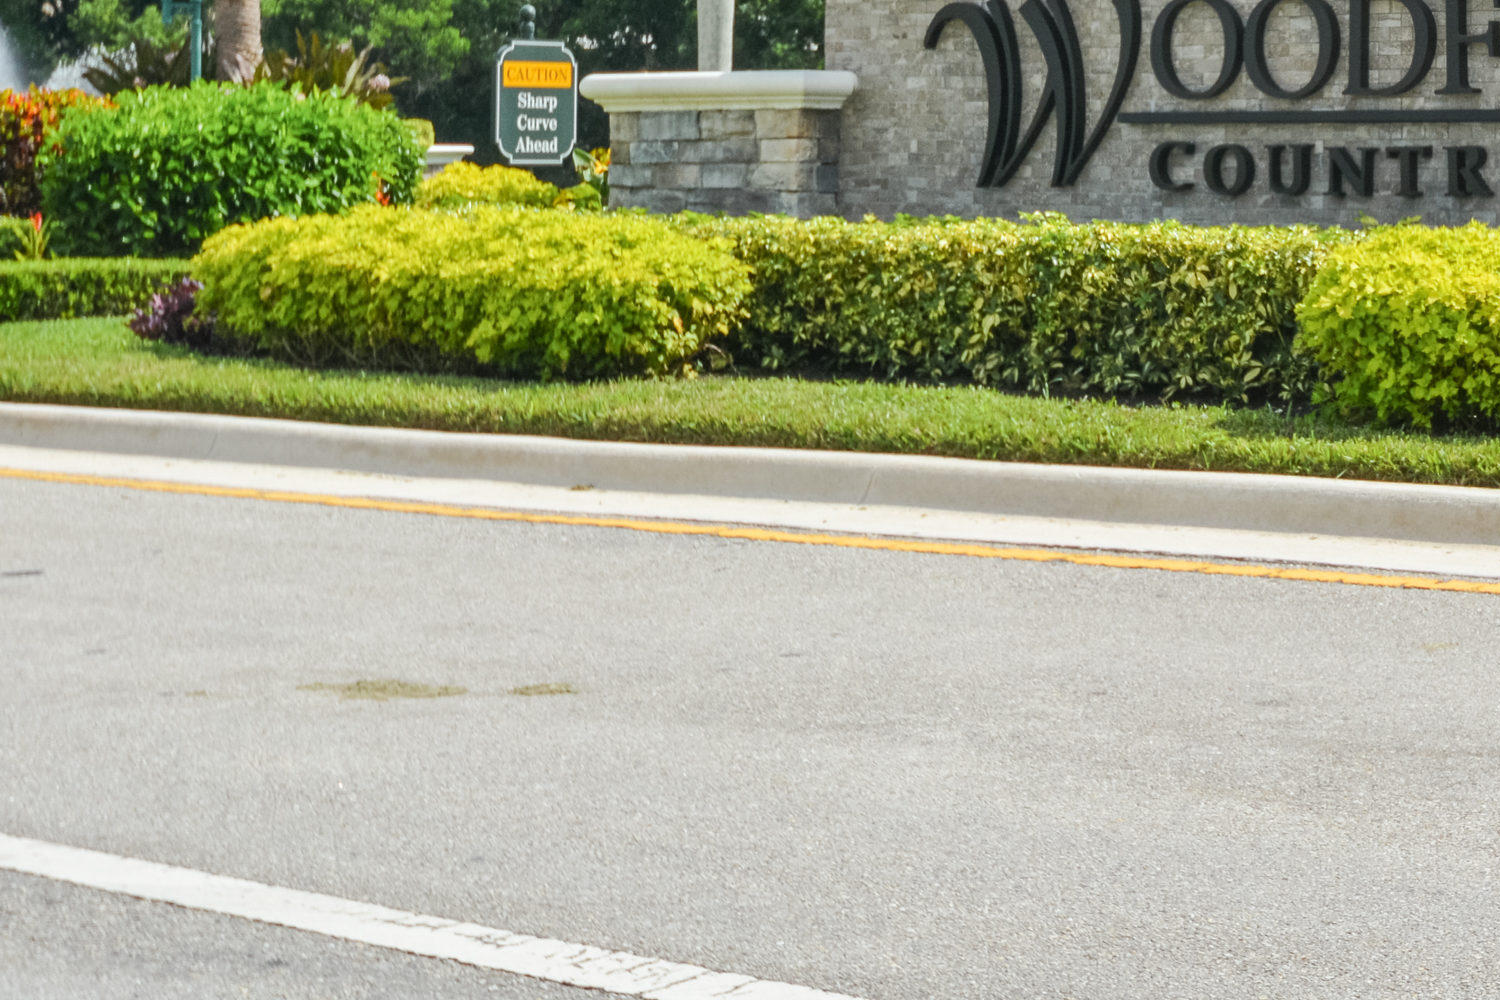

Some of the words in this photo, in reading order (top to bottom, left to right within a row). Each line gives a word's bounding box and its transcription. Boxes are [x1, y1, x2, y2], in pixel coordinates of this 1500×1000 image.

[507, 67, 567, 81] CAUTION
[517, 92, 557, 113] Sharp
[517, 114, 557, 131] Curve
[515, 136, 558, 153] Ahead
